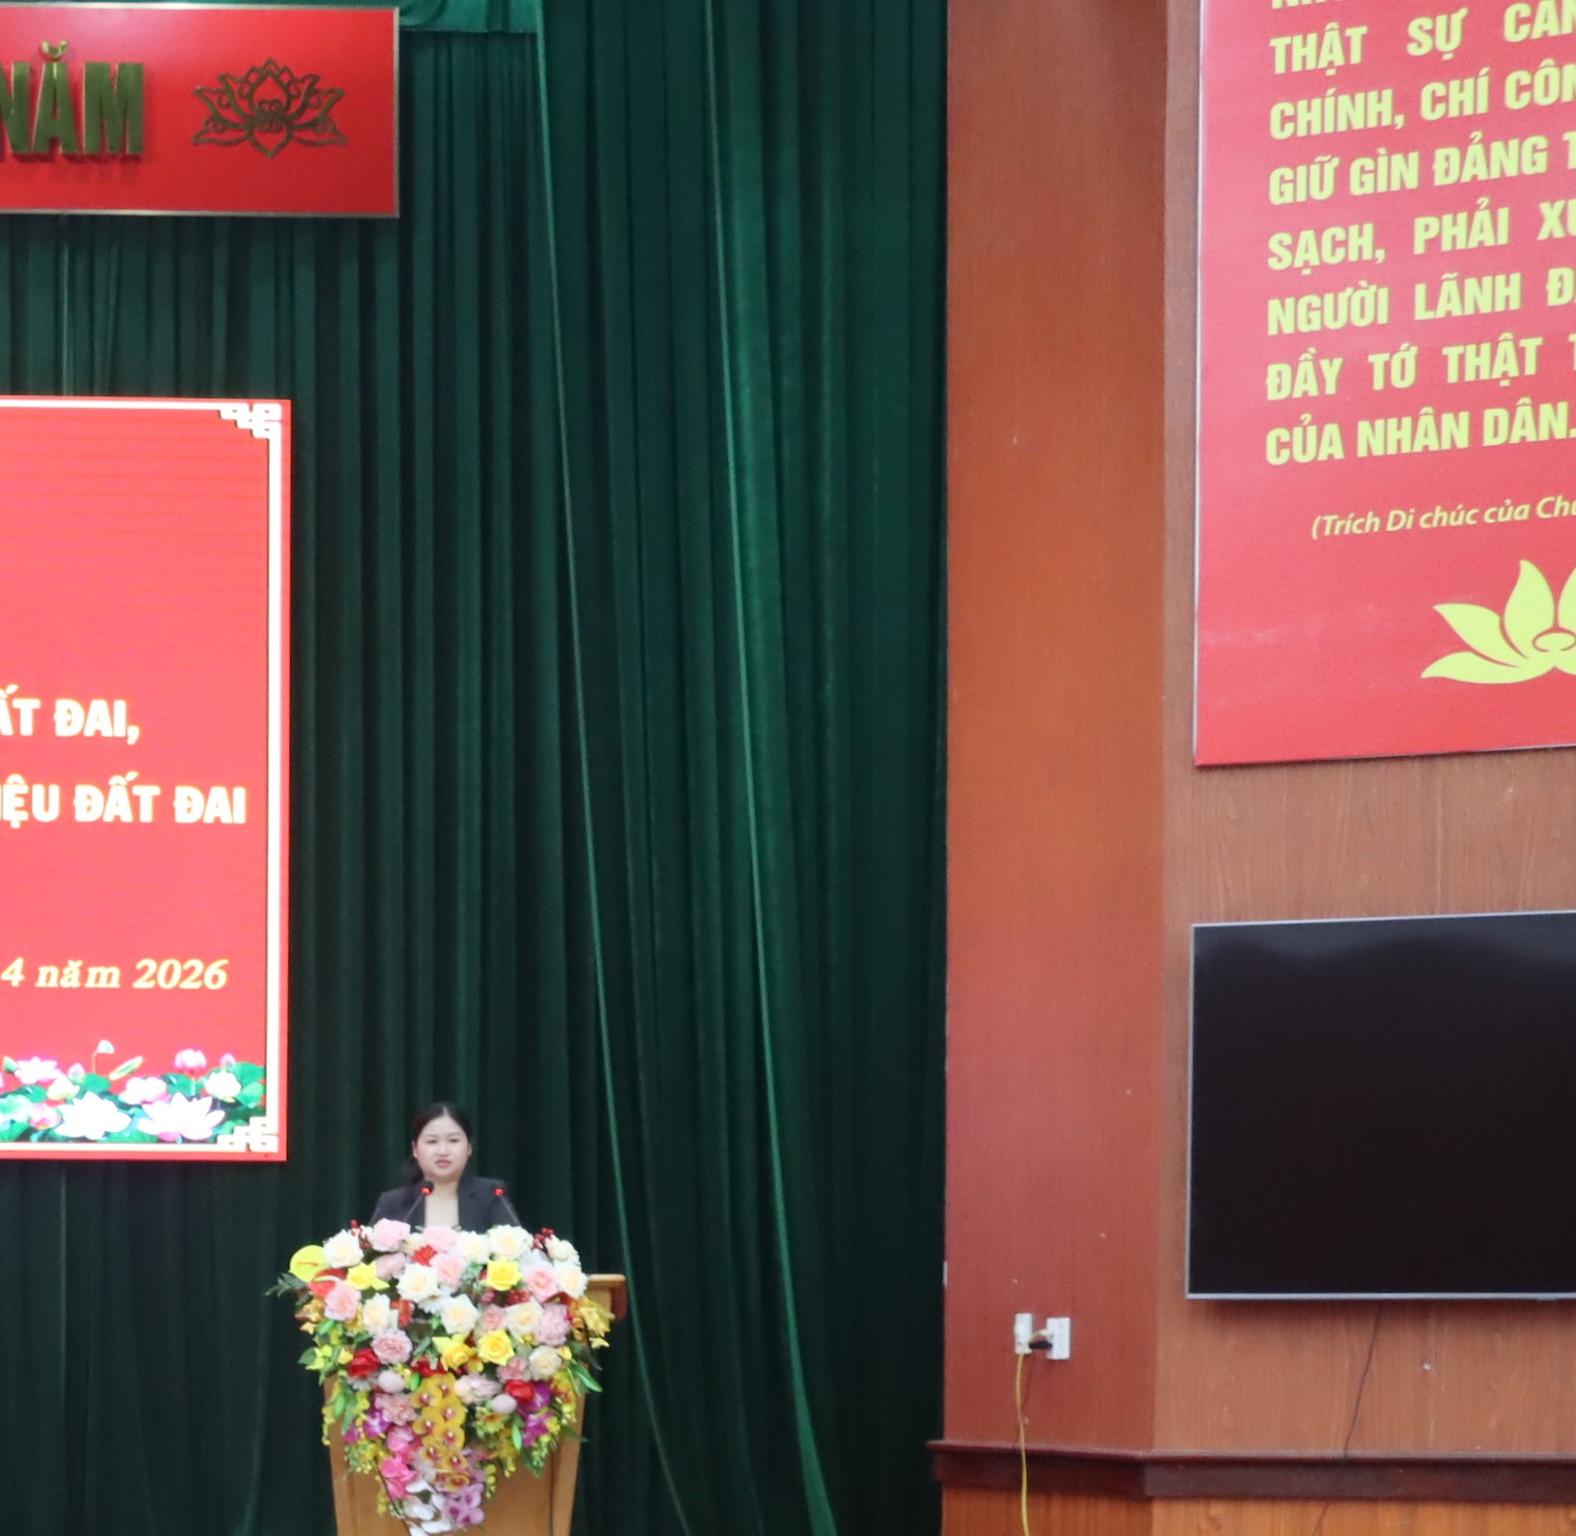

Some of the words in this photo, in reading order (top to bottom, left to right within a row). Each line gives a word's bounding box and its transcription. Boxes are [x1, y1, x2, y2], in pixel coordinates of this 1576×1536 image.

[1270, 22, 1368, 75] THẬT
[1407, 8, 1468, 60] SỰ
[1270, 88, 1404, 139] CHÍNH,
[1421, 67, 1489, 120] CHÍ
[1269, 155, 1340, 205] GIỮ
[1350, 148, 1419, 196] GÌN
[1433, 131, 1548, 185] ĐẢNG
[1268, 223, 1385, 275] SẠCH,
[1414, 197, 1509, 254] PHẢI
[1268, 280, 1389, 336] NGƯỜI
[1414, 272, 1521, 320] LÃNH
[1546, 267, 1576, 306] Đ
[1266, 347, 1343, 400] ĐẦY
[1368, 342, 1418, 390] TỚ
[1442, 332, 1543, 386] THẬT
[1266, 413, 1344, 465] CỦA
[1357, 407, 1469, 457] NHÂN
[1483, 397, 1576, 446] DÂN.
[1311, 511, 1381, 540] (Trích
[1386, 508, 1415, 531] Di
[1419, 504, 1479, 528] chúc
[1484, 499, 1531, 523] của
[54, 699, 139, 744] ĐAI,
[73, 772, 160, 822] ĐẤT
[174, 786, 246, 824] ĐAI
[1, 958, 24, 986] 4
[36, 960, 120, 988] năm
[133, 959, 228, 989] 2026
